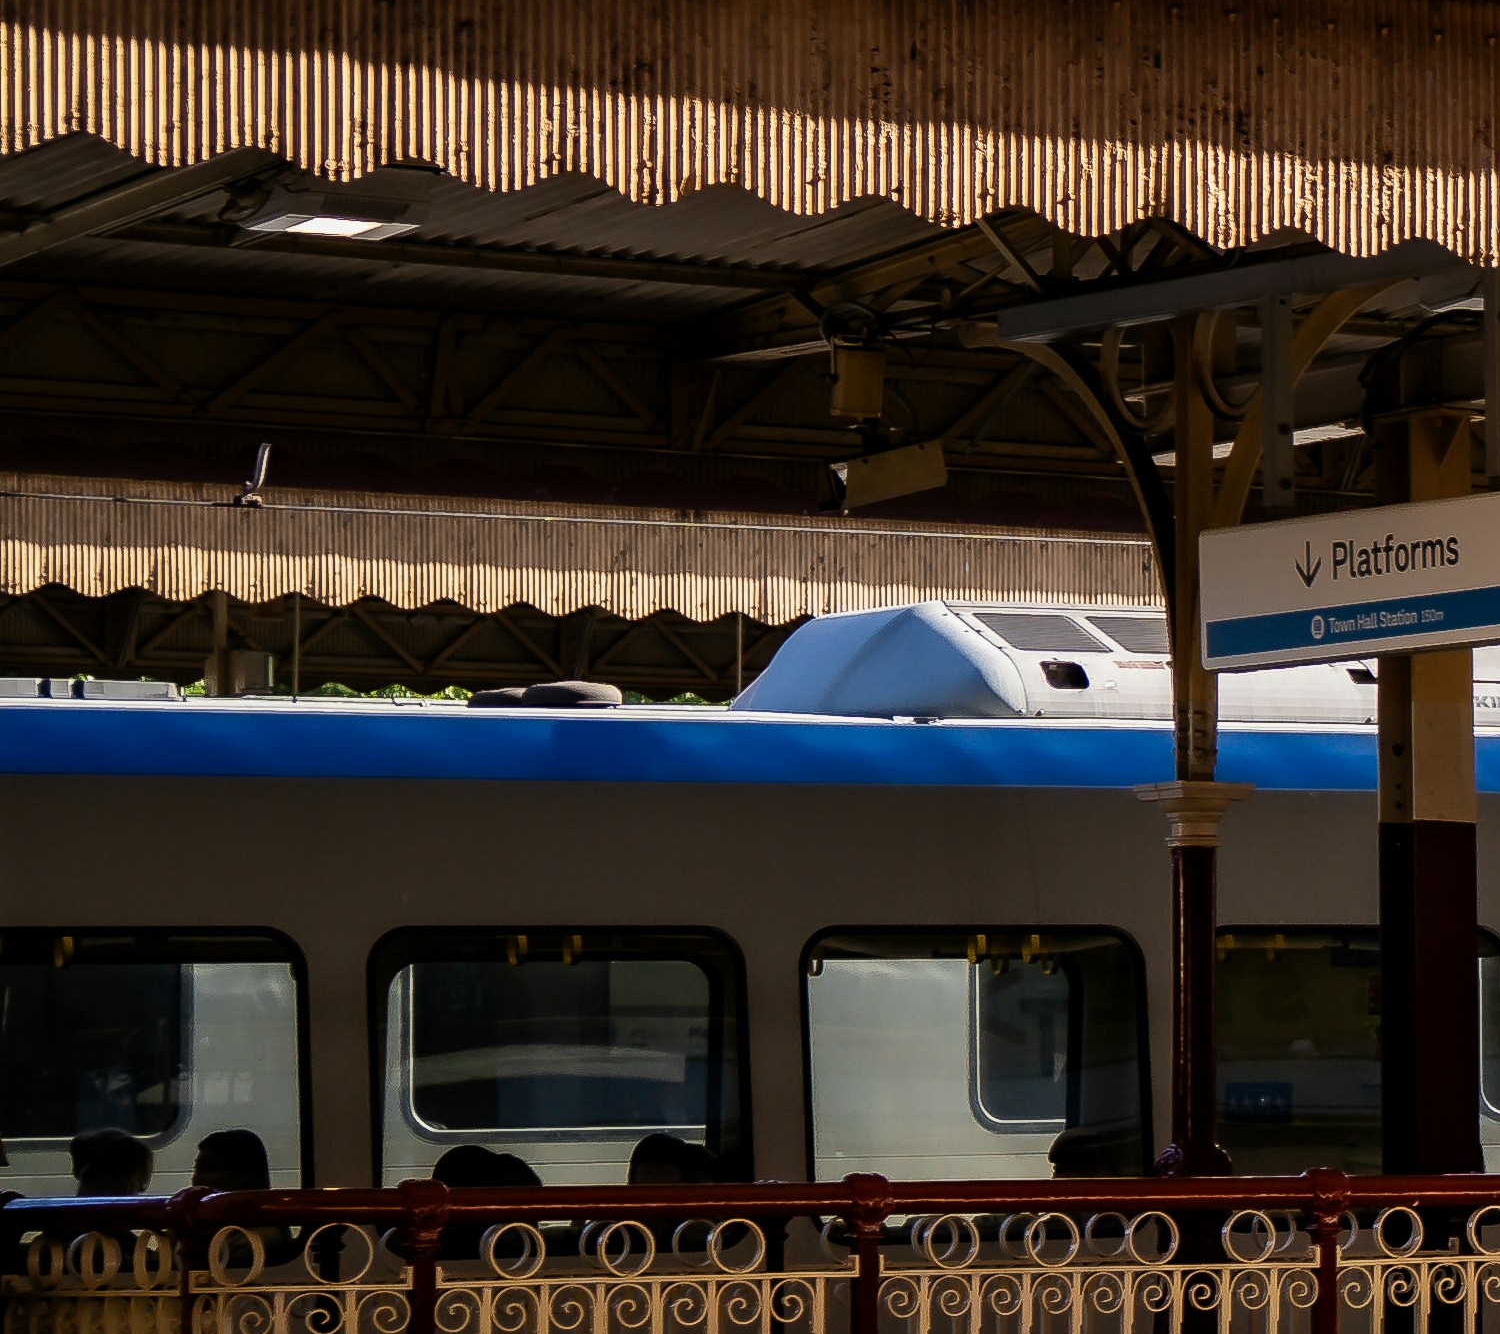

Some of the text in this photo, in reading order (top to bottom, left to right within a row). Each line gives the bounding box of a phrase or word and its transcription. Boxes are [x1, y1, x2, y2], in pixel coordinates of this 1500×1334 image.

[1331, 534, 1460, 582] Platforms
[1328, 617, 1357, 634] Town
[1358, 612, 1378, 630] Hall
[1379, 608, 1418, 627] Station
